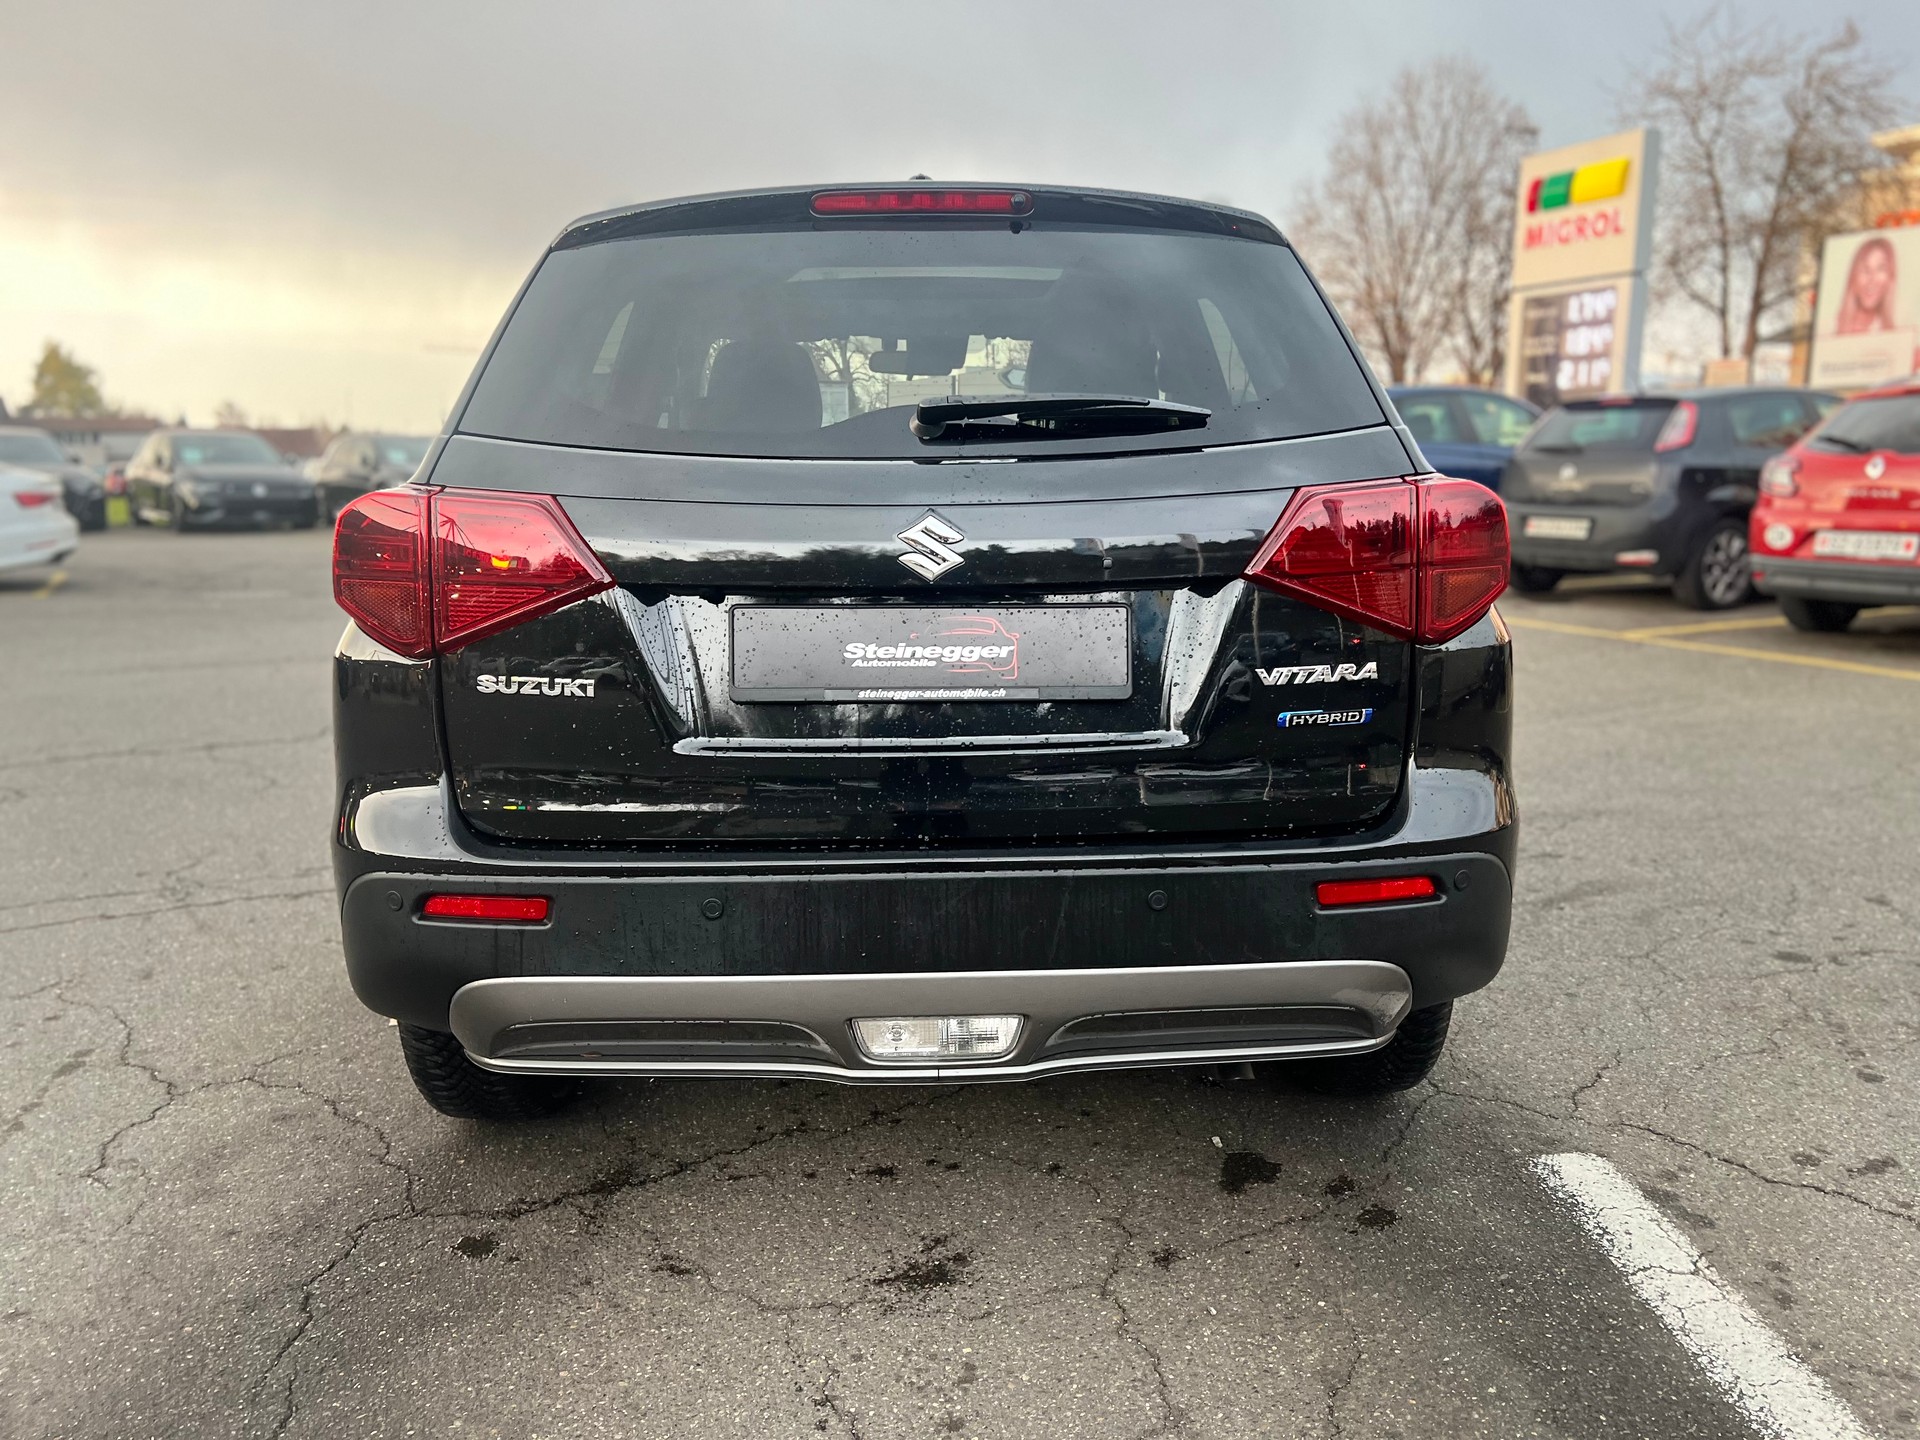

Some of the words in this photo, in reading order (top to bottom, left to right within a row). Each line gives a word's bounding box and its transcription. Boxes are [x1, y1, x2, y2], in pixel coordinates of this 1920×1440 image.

[1523, 208, 1625, 250] MIGROL
[843, 643, 1016, 662] Steinegger
[851, 659, 937, 668] Automobile
[1255, 661, 1378, 686] VITARA
[476, 674, 595, 698] SUZUKI
[857, 687, 1007, 700] steinegger-automobile.ch
[1292, 712, 1360, 726] HYBRID
